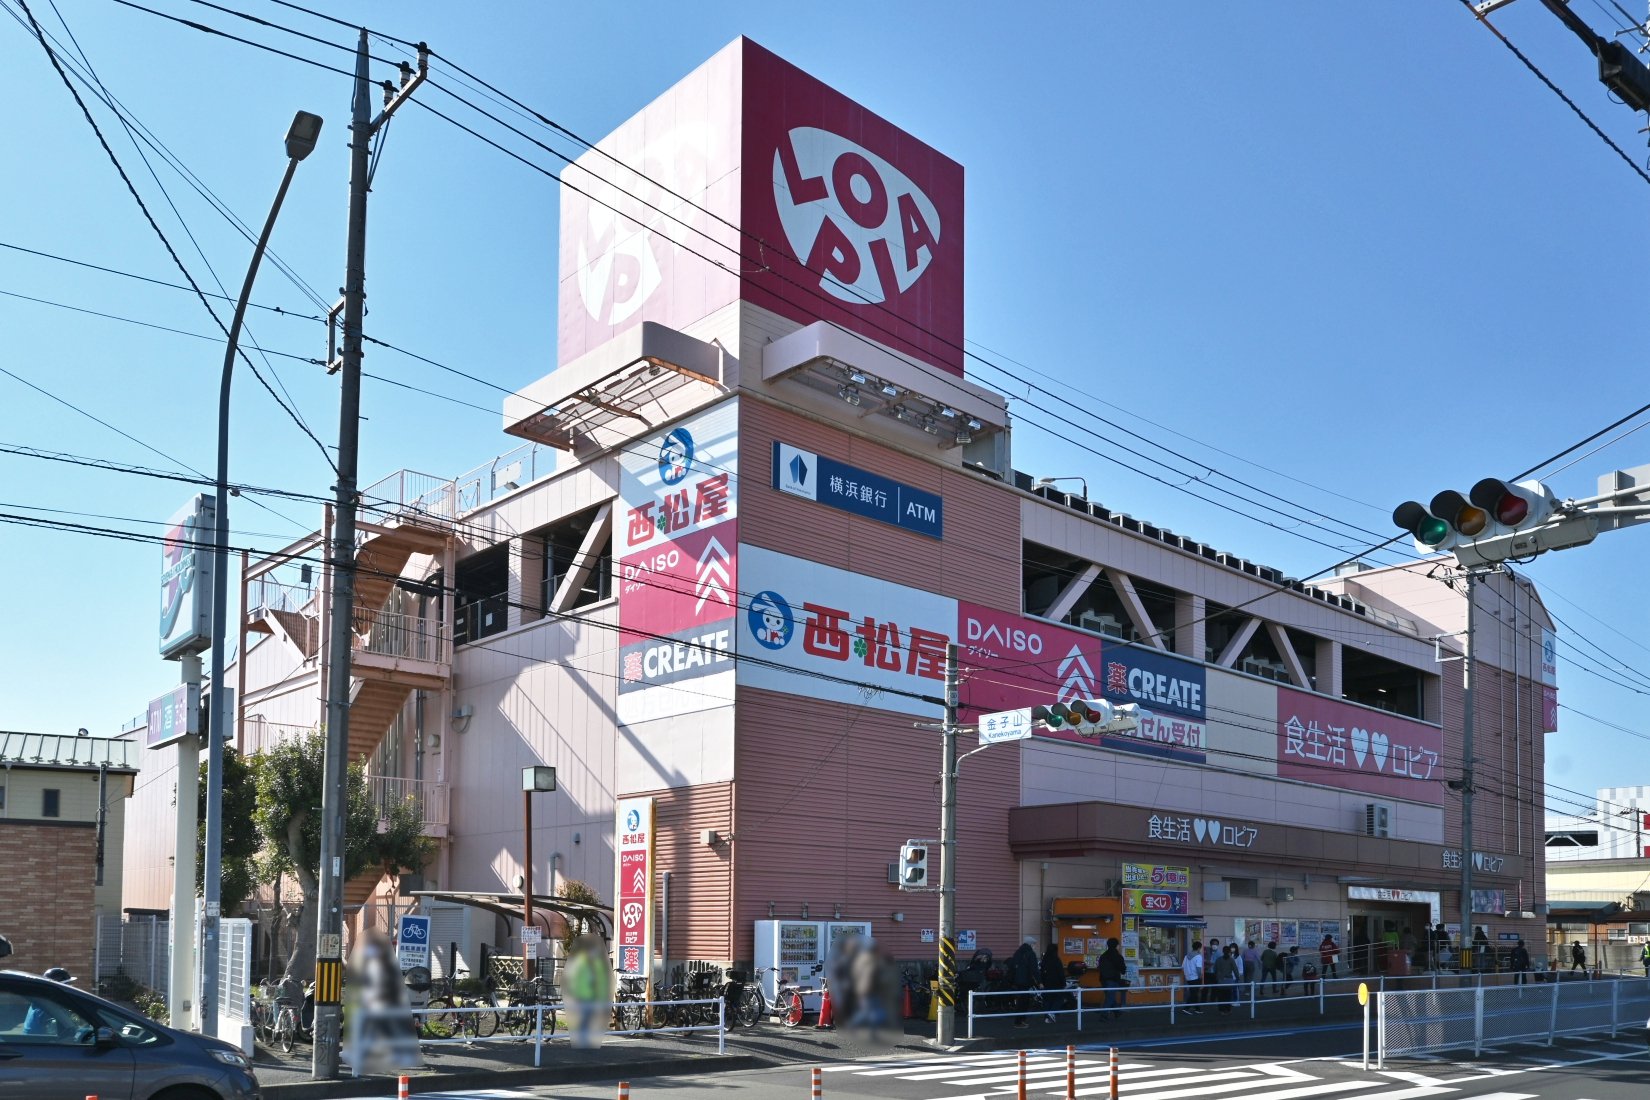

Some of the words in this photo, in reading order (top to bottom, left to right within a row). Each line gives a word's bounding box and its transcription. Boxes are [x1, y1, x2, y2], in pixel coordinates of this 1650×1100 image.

[774, 127, 941, 304] LOPIA
[627, 473, 729, 546] 西松屋
[829, 475, 888, 508] 横浜銀行
[906, 502, 936, 523] ATM
[624, 549, 679, 583] DAISO
[643, 629, 729, 679] CREATE
[803, 602, 949, 681] 西松屋
[967, 617, 1043, 655] DAISO
[1107, 661, 1127, 695] 薬
[1128, 667, 1201, 712] CREATE
[986, 714, 1023, 731] 金子山
[988, 729, 1022, 739] Kanekoyama
[1122, 717, 1201, 749] せん受付
[1284, 714, 1347, 767] 食生活
[1392, 743, 1439, 781] ロピア
[622, 833, 645, 845] 西松屋
[1147, 813, 1191, 842] 食生活
[1222, 826, 1258, 849] ロピア
[622, 854, 645, 862] DAISO
[1145, 896, 1167, 909] 宝くじ
